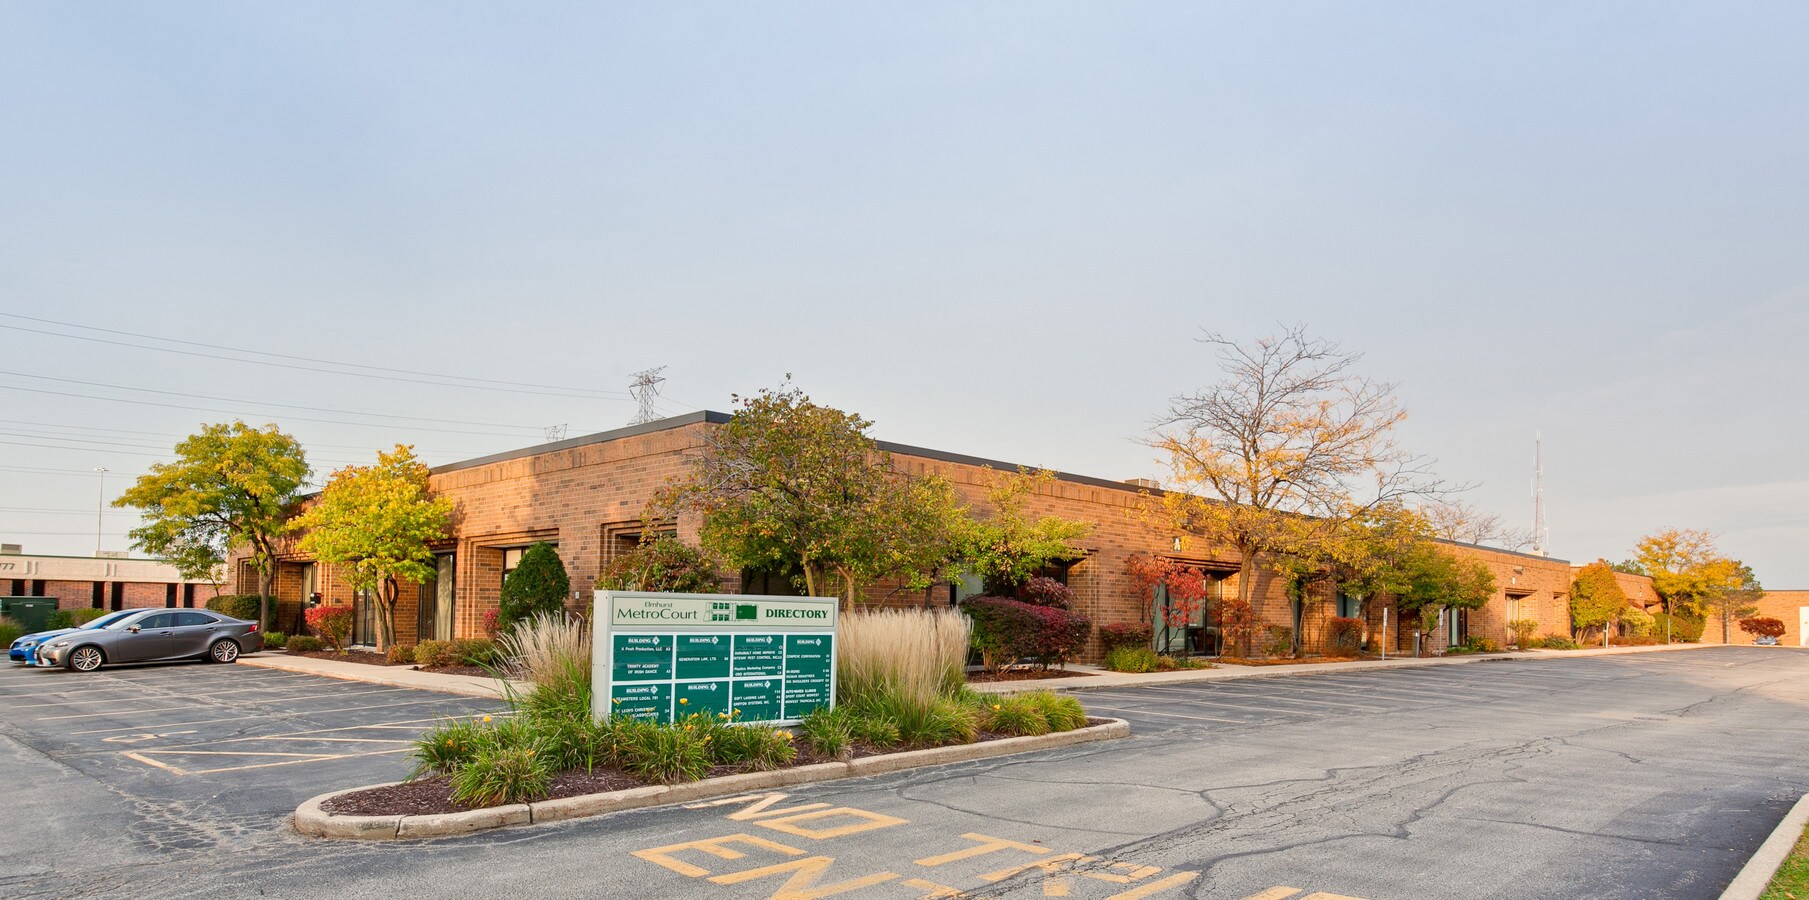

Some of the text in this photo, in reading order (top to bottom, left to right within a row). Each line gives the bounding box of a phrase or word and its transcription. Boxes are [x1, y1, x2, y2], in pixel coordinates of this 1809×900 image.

[0, 562, 15, 570] 77
[617, 608, 698, 620] MetroCourt
[766, 609, 828, 619] DIRECTORY
[683, 792, 911, 840] NO
